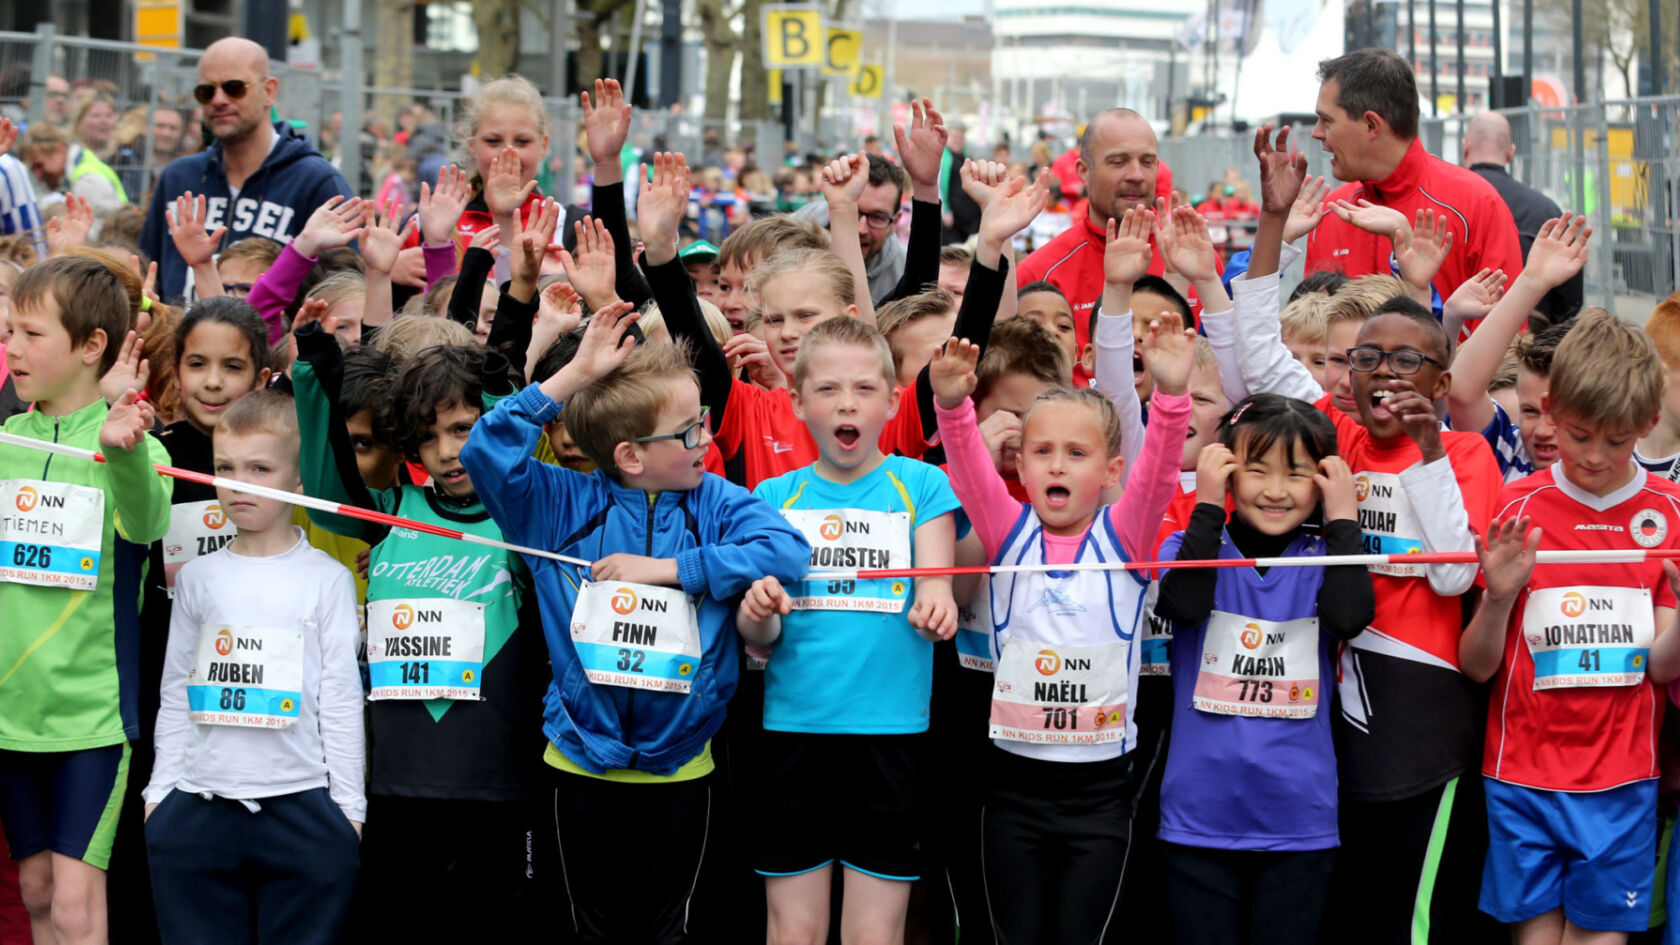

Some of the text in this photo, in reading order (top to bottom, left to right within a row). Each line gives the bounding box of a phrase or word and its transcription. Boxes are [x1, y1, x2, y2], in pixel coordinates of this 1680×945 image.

[781, 17, 809, 58] B
[828, 33, 852, 71] C
[856, 66, 878, 95] D
[41, 495, 65, 508] NN
[1372, 485, 1392, 498] NN
[846, 521, 870, 534] NN
[1358, 508, 1397, 533] ZUAH
[13, 543, 52, 569] 626
[372, 554, 491, 580] OTTERDAM
[810, 547, 890, 569] HORSTEN
[17, 570, 38, 580] RUN
[63, 575, 87, 585] 2015
[404, 577, 472, 600] ATLETIEK
[641, 597, 668, 613] NN
[826, 599, 849, 608] RUN
[877, 601, 900, 610] 2015
[1589, 599, 1613, 611] NN
[417, 610, 442, 623] NN
[237, 637, 263, 651] NN
[612, 621, 657, 646] FINN
[1266, 632, 1286, 645] NN
[1544, 624, 1634, 646] JONATHAN
[385, 636, 452, 656] YASSINE
[616, 648, 646, 673] 32
[1064, 658, 1091, 670] NN
[1231, 654, 1285, 676] KARIN
[1578, 649, 1600, 671] 41
[207, 662, 264, 684] RUBEN
[400, 662, 429, 684] 141
[615, 674, 638, 686] RUN
[1575, 676, 1599, 685] RUN
[219, 688, 246, 711] 86
[401, 688, 422, 697] RUN
[447, 688, 469, 698] 2015
[1034, 680, 1088, 702] NAËLL
[1239, 680, 1273, 703] 773
[218, 714, 240, 724] RUN
[265, 717, 287, 727] 2015
[1042, 707, 1078, 730] 701
[1240, 705, 1263, 715] RUN
[1019, 731, 1043, 741] KIDS
[1045, 733, 1069, 743] RUN
